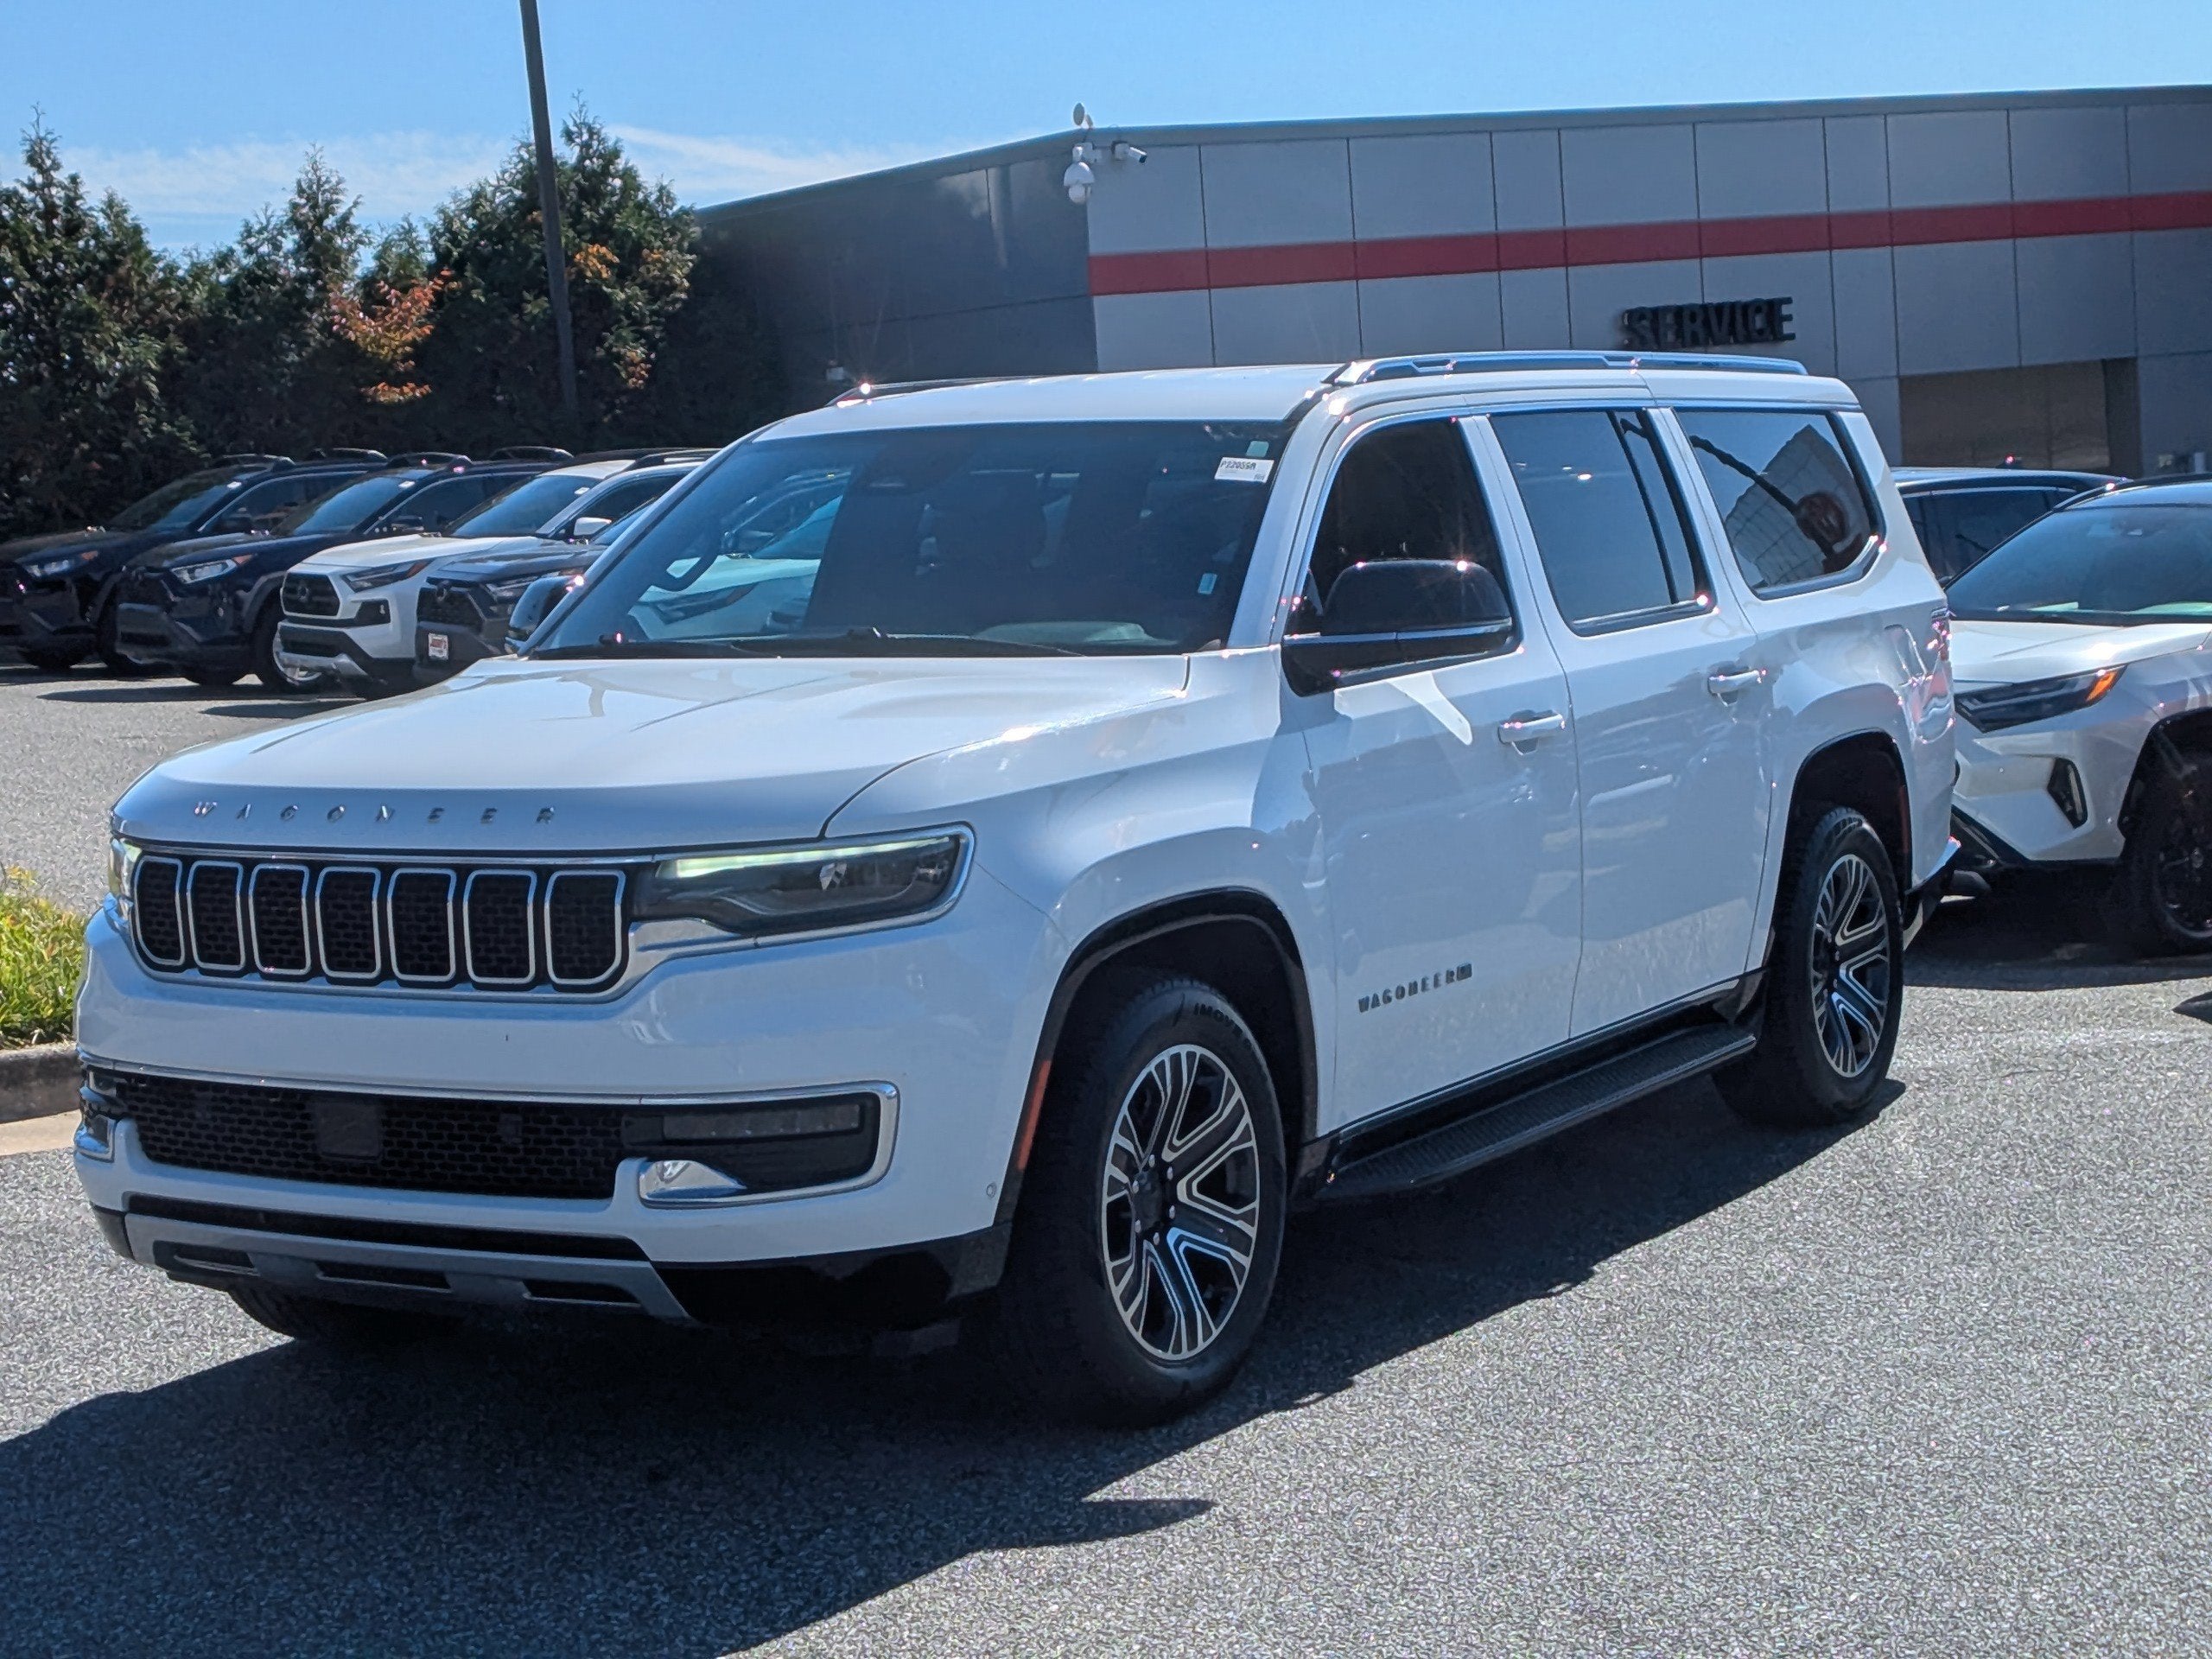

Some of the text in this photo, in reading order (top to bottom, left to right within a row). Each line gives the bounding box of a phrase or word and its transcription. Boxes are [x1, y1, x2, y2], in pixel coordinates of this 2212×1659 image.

[1621, 296, 1796, 348] SERVICE
[193, 800, 556, 825] WAGONEER
[1357, 968, 1456, 1014] WAGONEER
